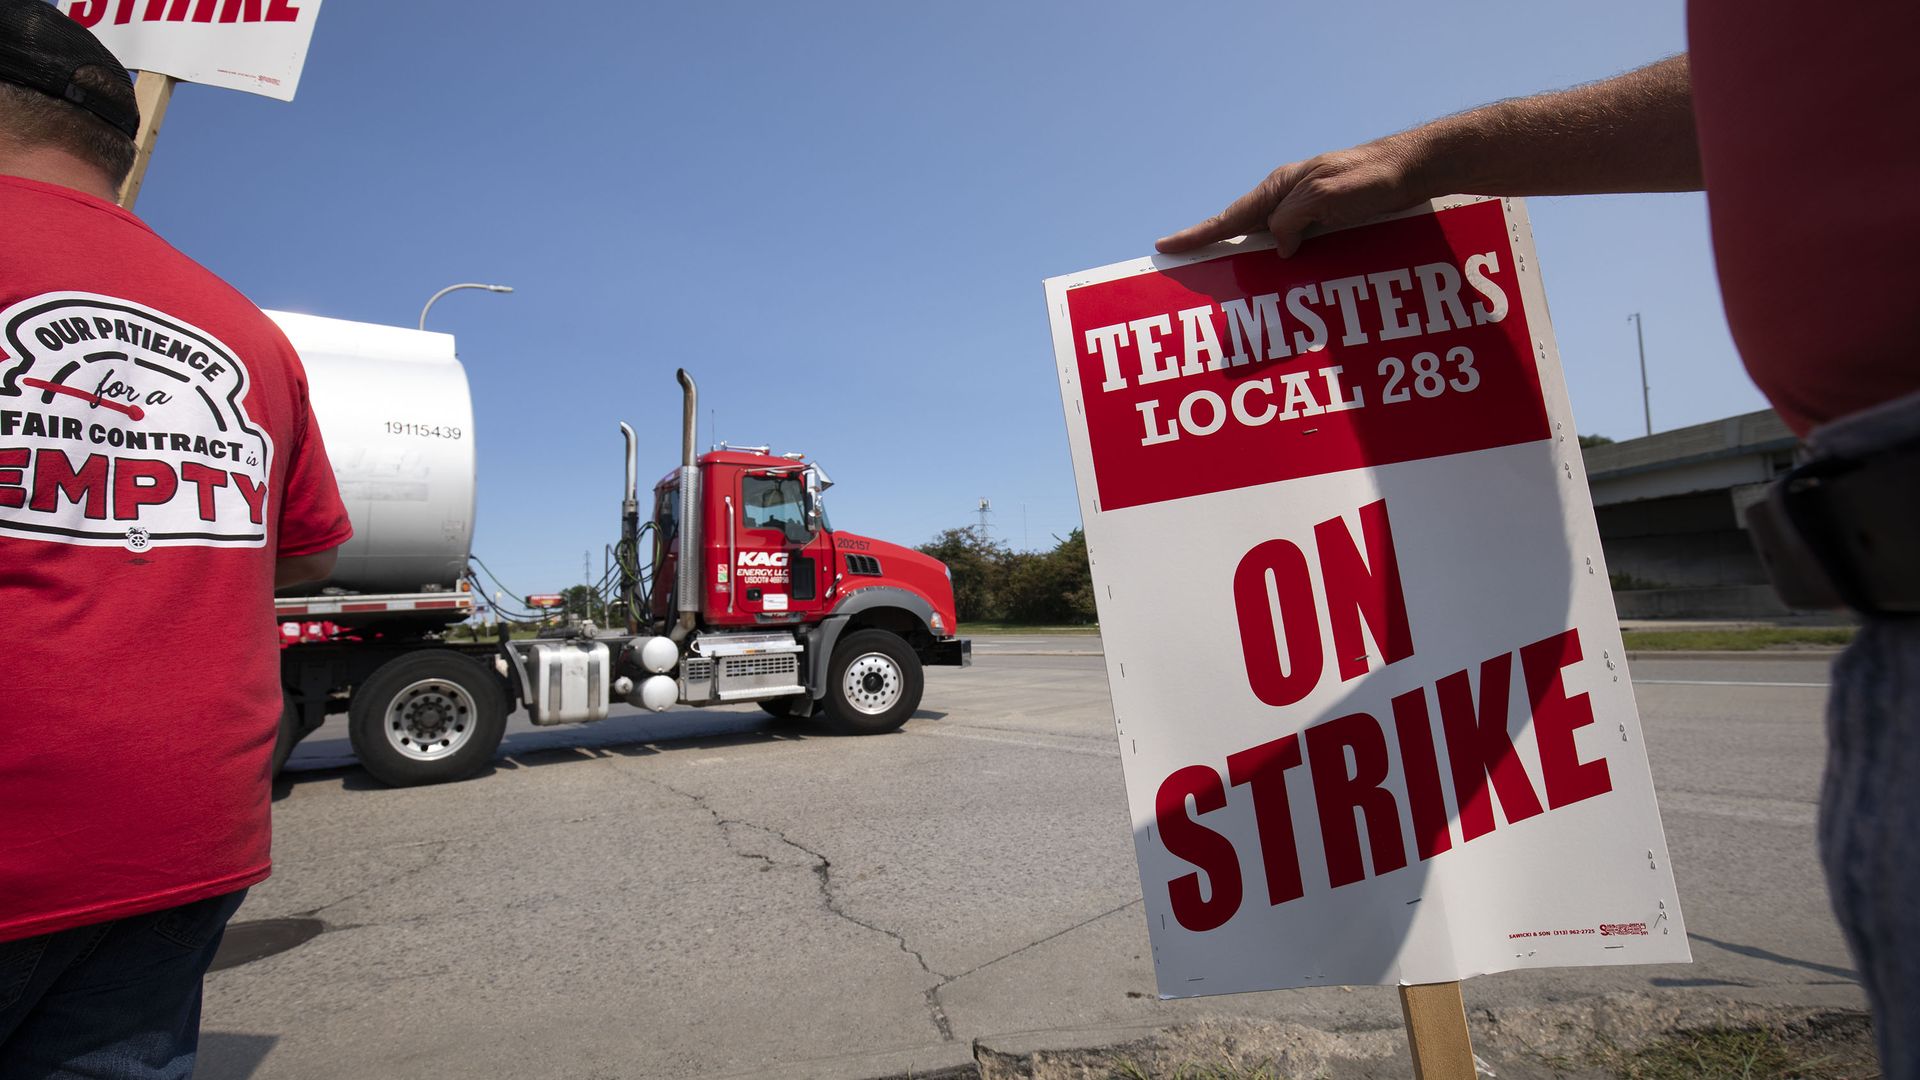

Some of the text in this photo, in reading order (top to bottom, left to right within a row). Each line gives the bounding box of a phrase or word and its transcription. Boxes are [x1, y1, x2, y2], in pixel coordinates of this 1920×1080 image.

[35, 316, 227, 382] OUR PATIENCE
[1085, 251, 1509, 393] TEAMSTERS
[89, 368, 172, 409] for a
[1135, 345, 1481, 447] LOCAL 283
[0, 410, 259, 466] FAIR CONTRACT is
[384, 421, 461, 440] 19115439
[737, 551, 789, 567] KAG
[837, 537, 870, 550] 202157
[774, 568, 789, 576] LLC
[1233, 497, 1415, 707] ON
[1155, 627, 1613, 932] STRIKE
